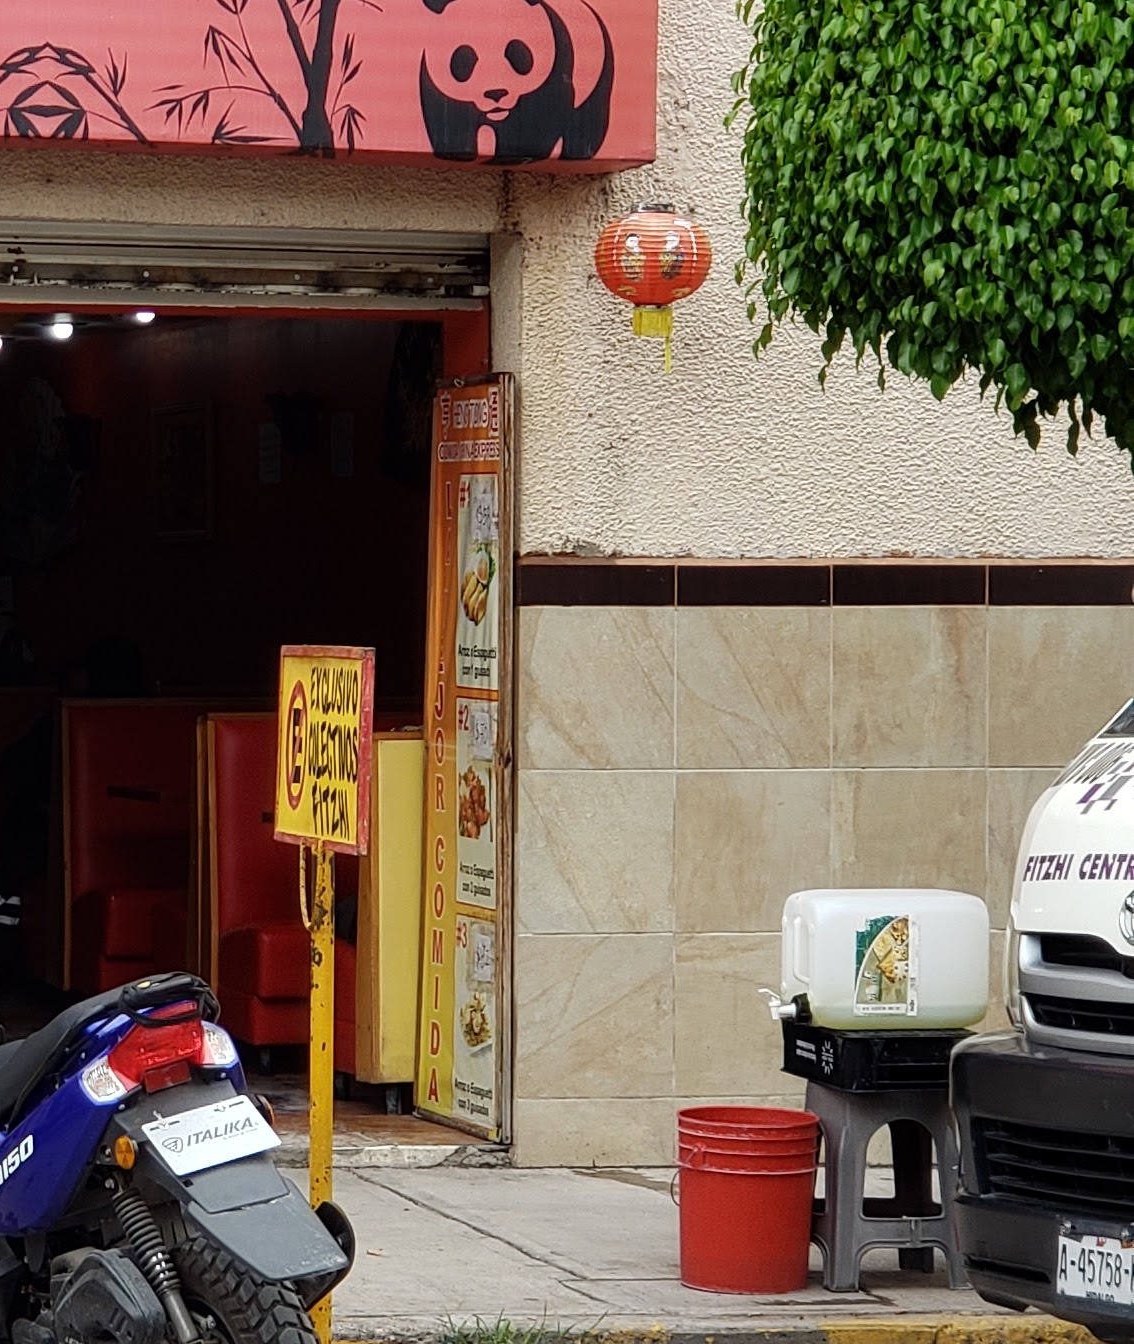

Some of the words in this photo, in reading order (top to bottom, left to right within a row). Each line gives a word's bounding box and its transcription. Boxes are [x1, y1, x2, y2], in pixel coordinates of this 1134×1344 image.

[310, 666, 358, 716] EXCLUSIVO
[308, 720, 358, 784] COLECTIVOS
[311, 782, 350, 841] FITZHI
[1023, 854, 1074, 882] FITZHI
[428, 836, 445, 1104] COMIDA
[187, 1117, 253, 1146] ITALIKA
